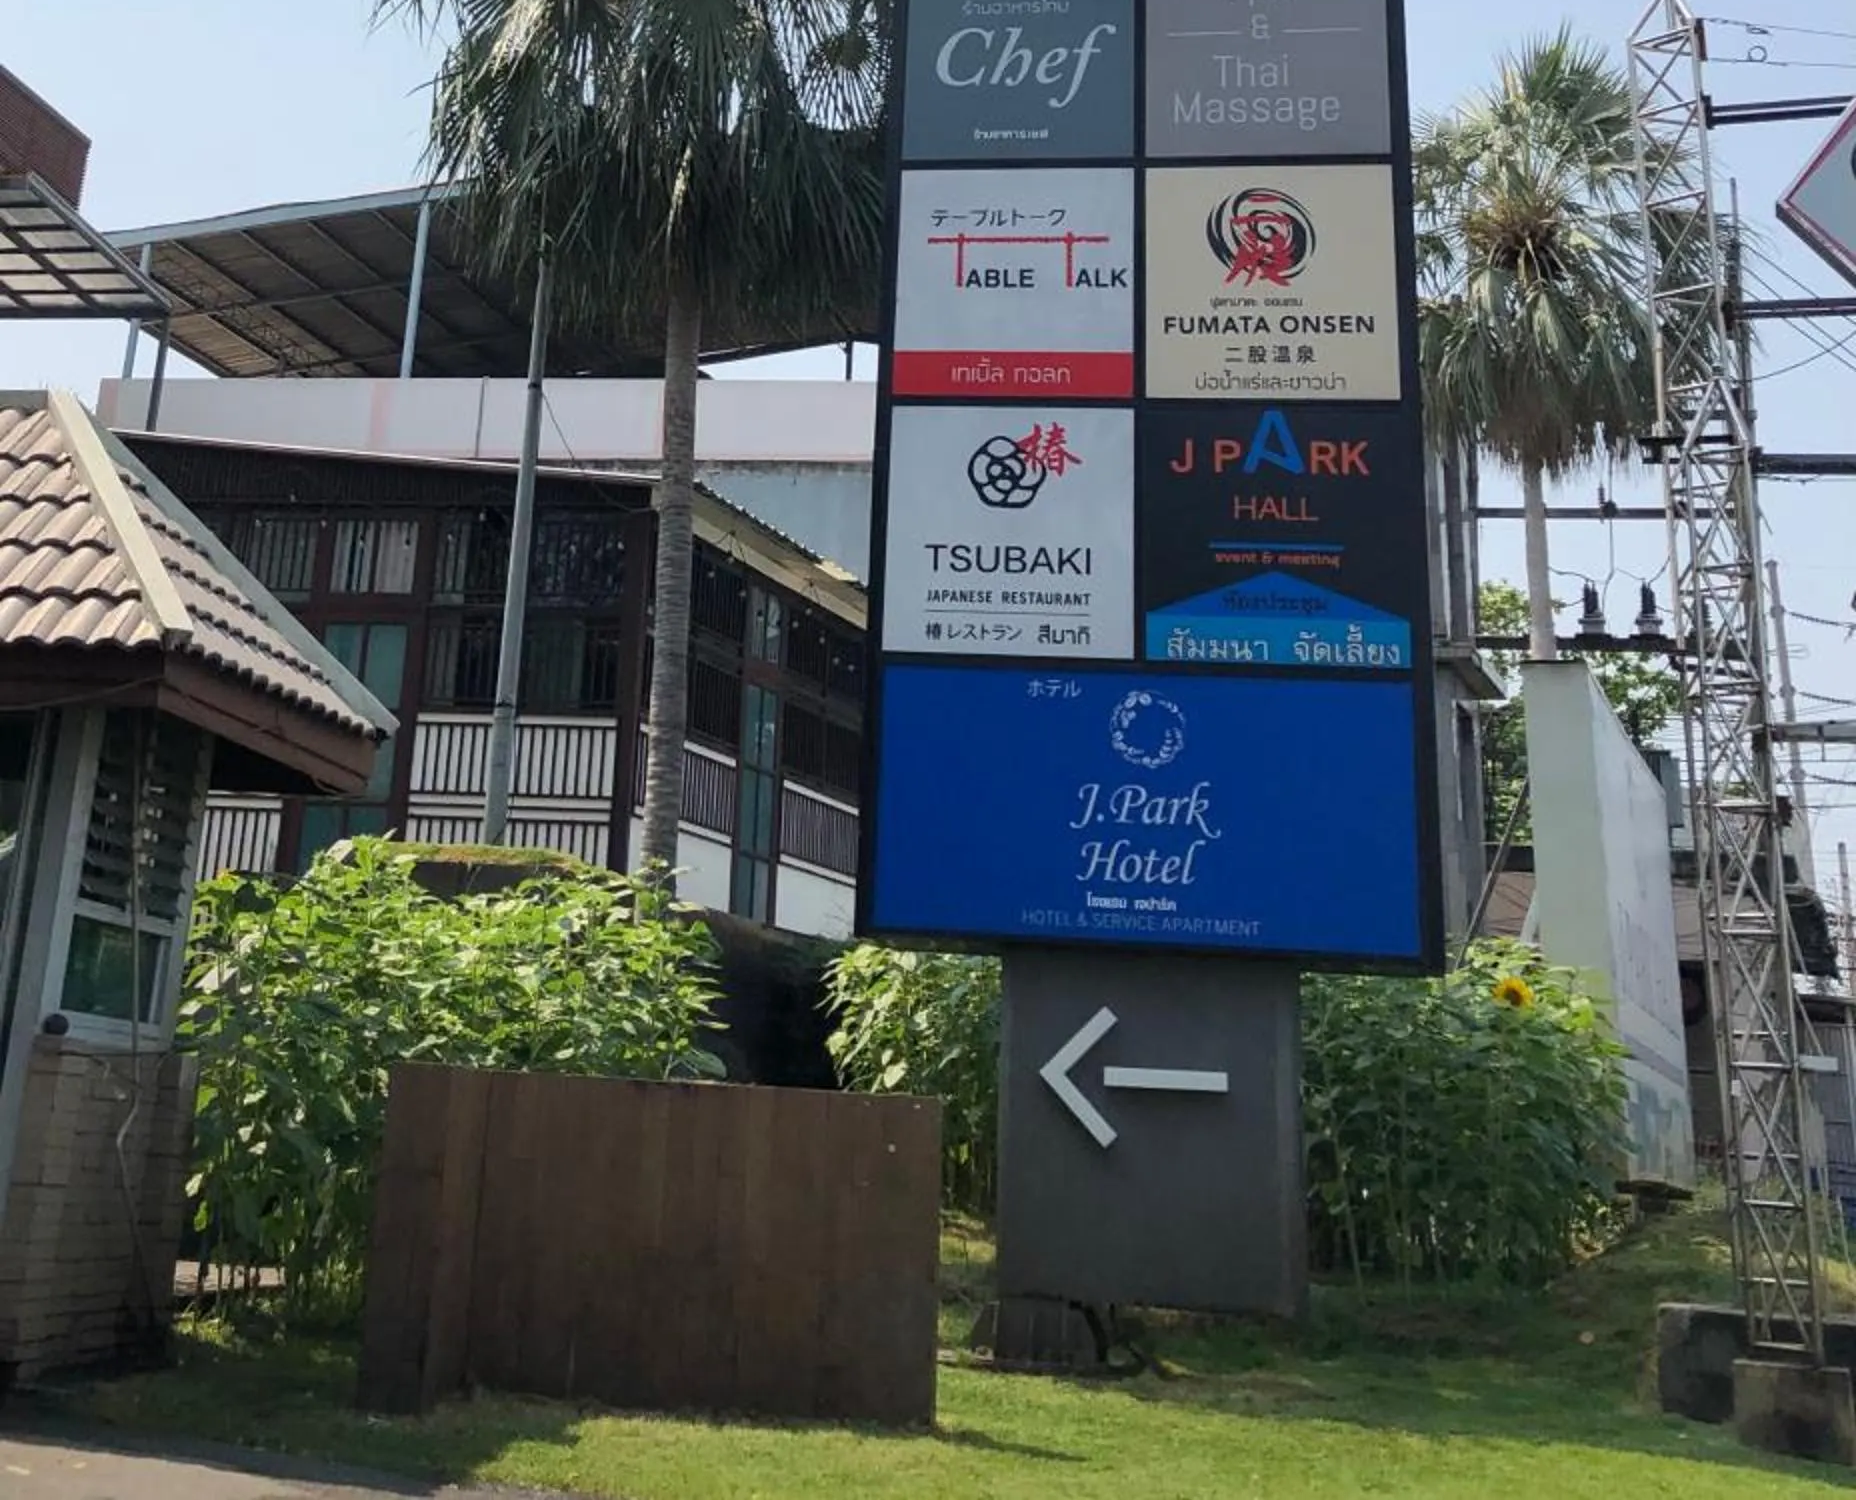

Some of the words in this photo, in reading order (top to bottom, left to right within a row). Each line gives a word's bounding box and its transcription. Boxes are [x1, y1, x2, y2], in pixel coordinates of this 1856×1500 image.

[1250, 12, 1271, 40] &
[935, 23, 1117, 109] Chef
[1212, 53, 1289, 88] Thai
[1173, 91, 1341, 131] Massage
[931, 208, 1067, 228] テーブルトーク
[1163, 315, 1271, 335] FUMATA
[1279, 315, 1376, 334] ONSEN
[1168, 438, 1195, 474] J
[1212, 409, 1371, 477] PARK
[1233, 495, 1320, 522] HALL
[924, 543, 1093, 576] TSUBAKI
[1215, 552, 1257, 564] event
[1278, 554, 1341, 568] meeting
[926, 588, 994, 605] JAPANESE
[1002, 590, 1092, 607] RESTAURANT
[1026, 678, 1083, 699] ホテル
[1068, 781, 1222, 840] J.Park
[1075, 839, 1207, 886] Hotel
[1021, 908, 1071, 928] HOTEL
[1076, 911, 1089, 928] &
[1092, 912, 1156, 932] SERVICE
[1162, 916, 1263, 937] APARTMENT
